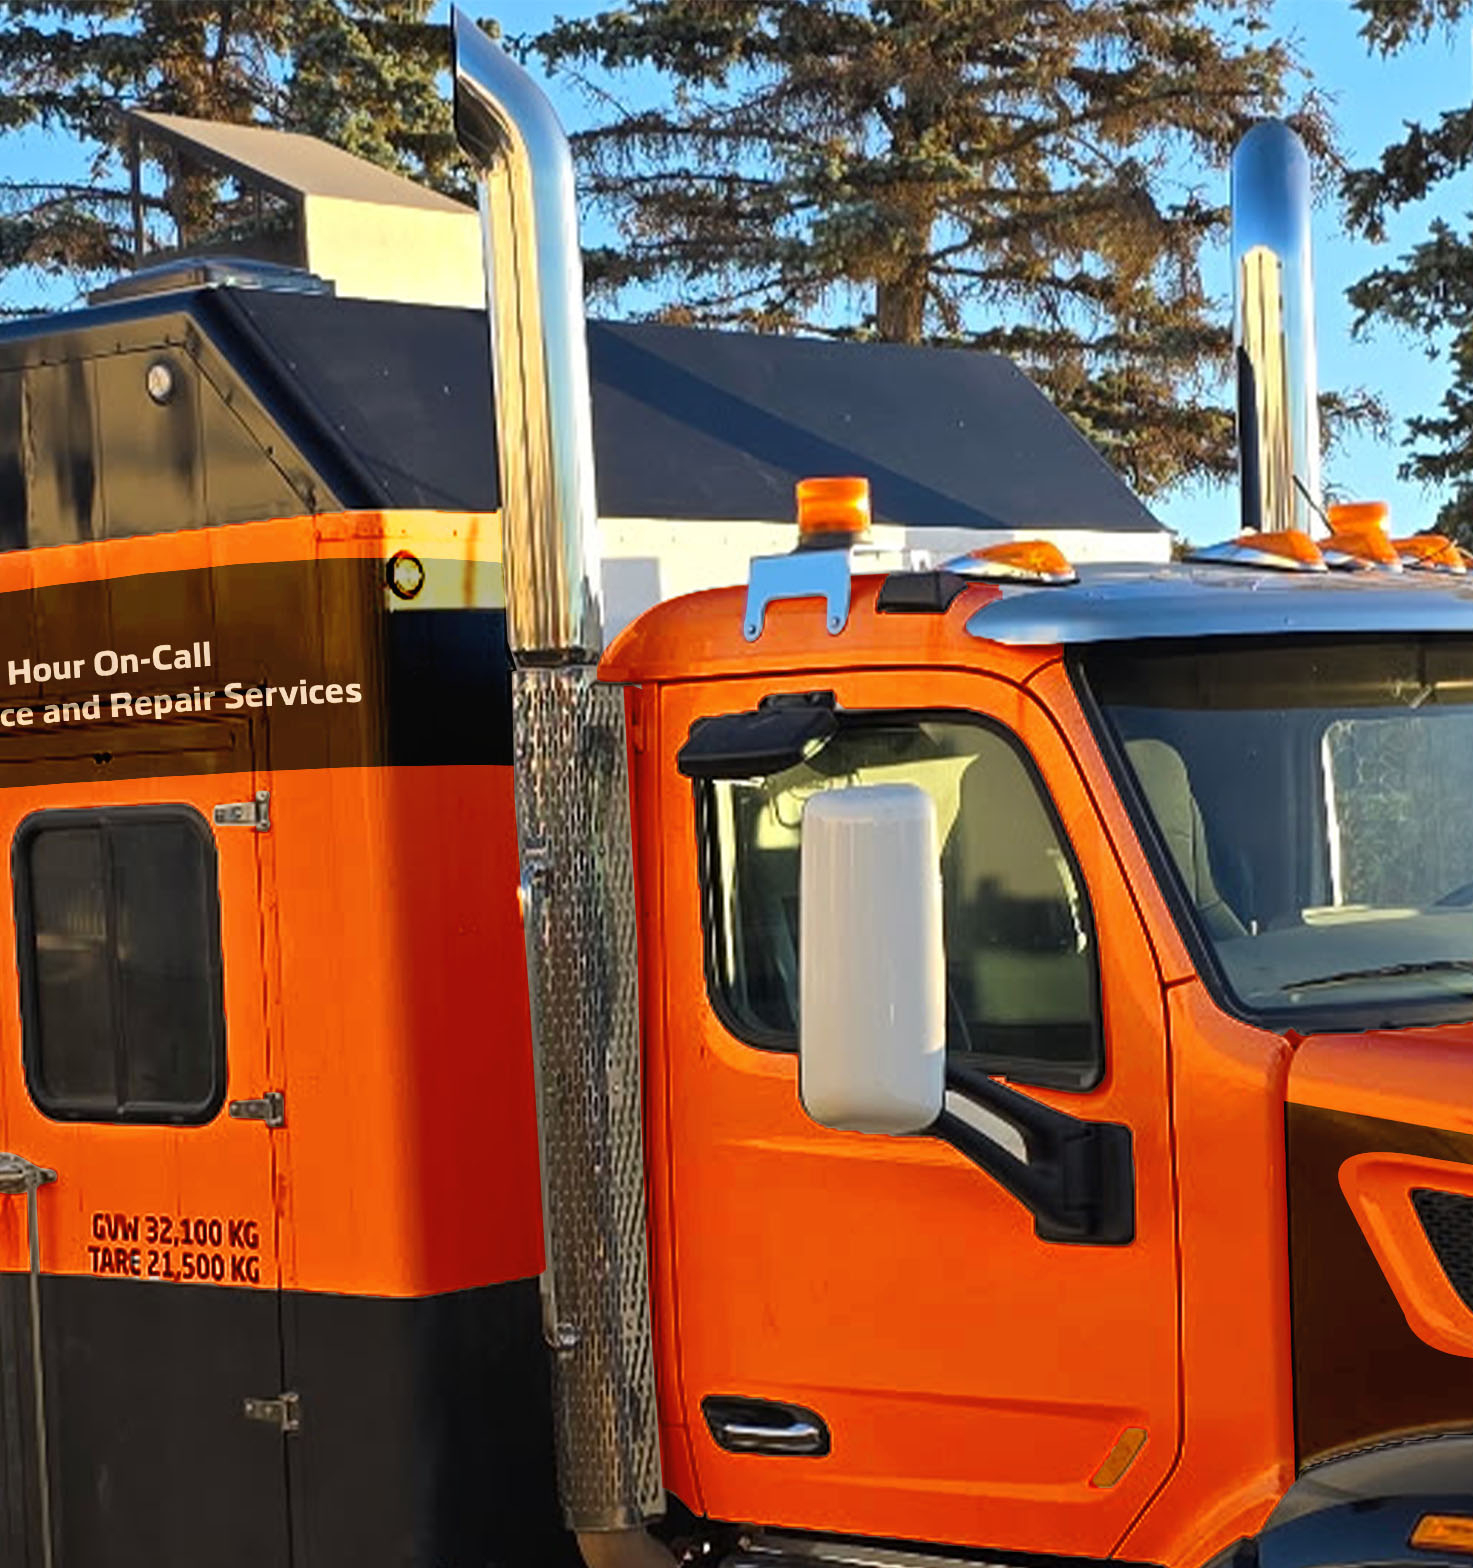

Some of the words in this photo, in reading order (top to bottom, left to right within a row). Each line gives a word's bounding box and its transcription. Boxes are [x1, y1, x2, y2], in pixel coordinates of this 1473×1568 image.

[7, 657, 85, 686] Hour
[94, 641, 211, 677] On-Call
[43, 694, 101, 724] and
[110, 687, 216, 720] Repair
[224, 679, 362, 709] Services
[92, 1212, 140, 1242] GVW
[144, 1215, 223, 1248] 32,100
[228, 1218, 260, 1250] KG
[87, 1245, 141, 1277] TARE
[146, 1249, 225, 1283] 21,500
[230, 1253, 260, 1284] KG
